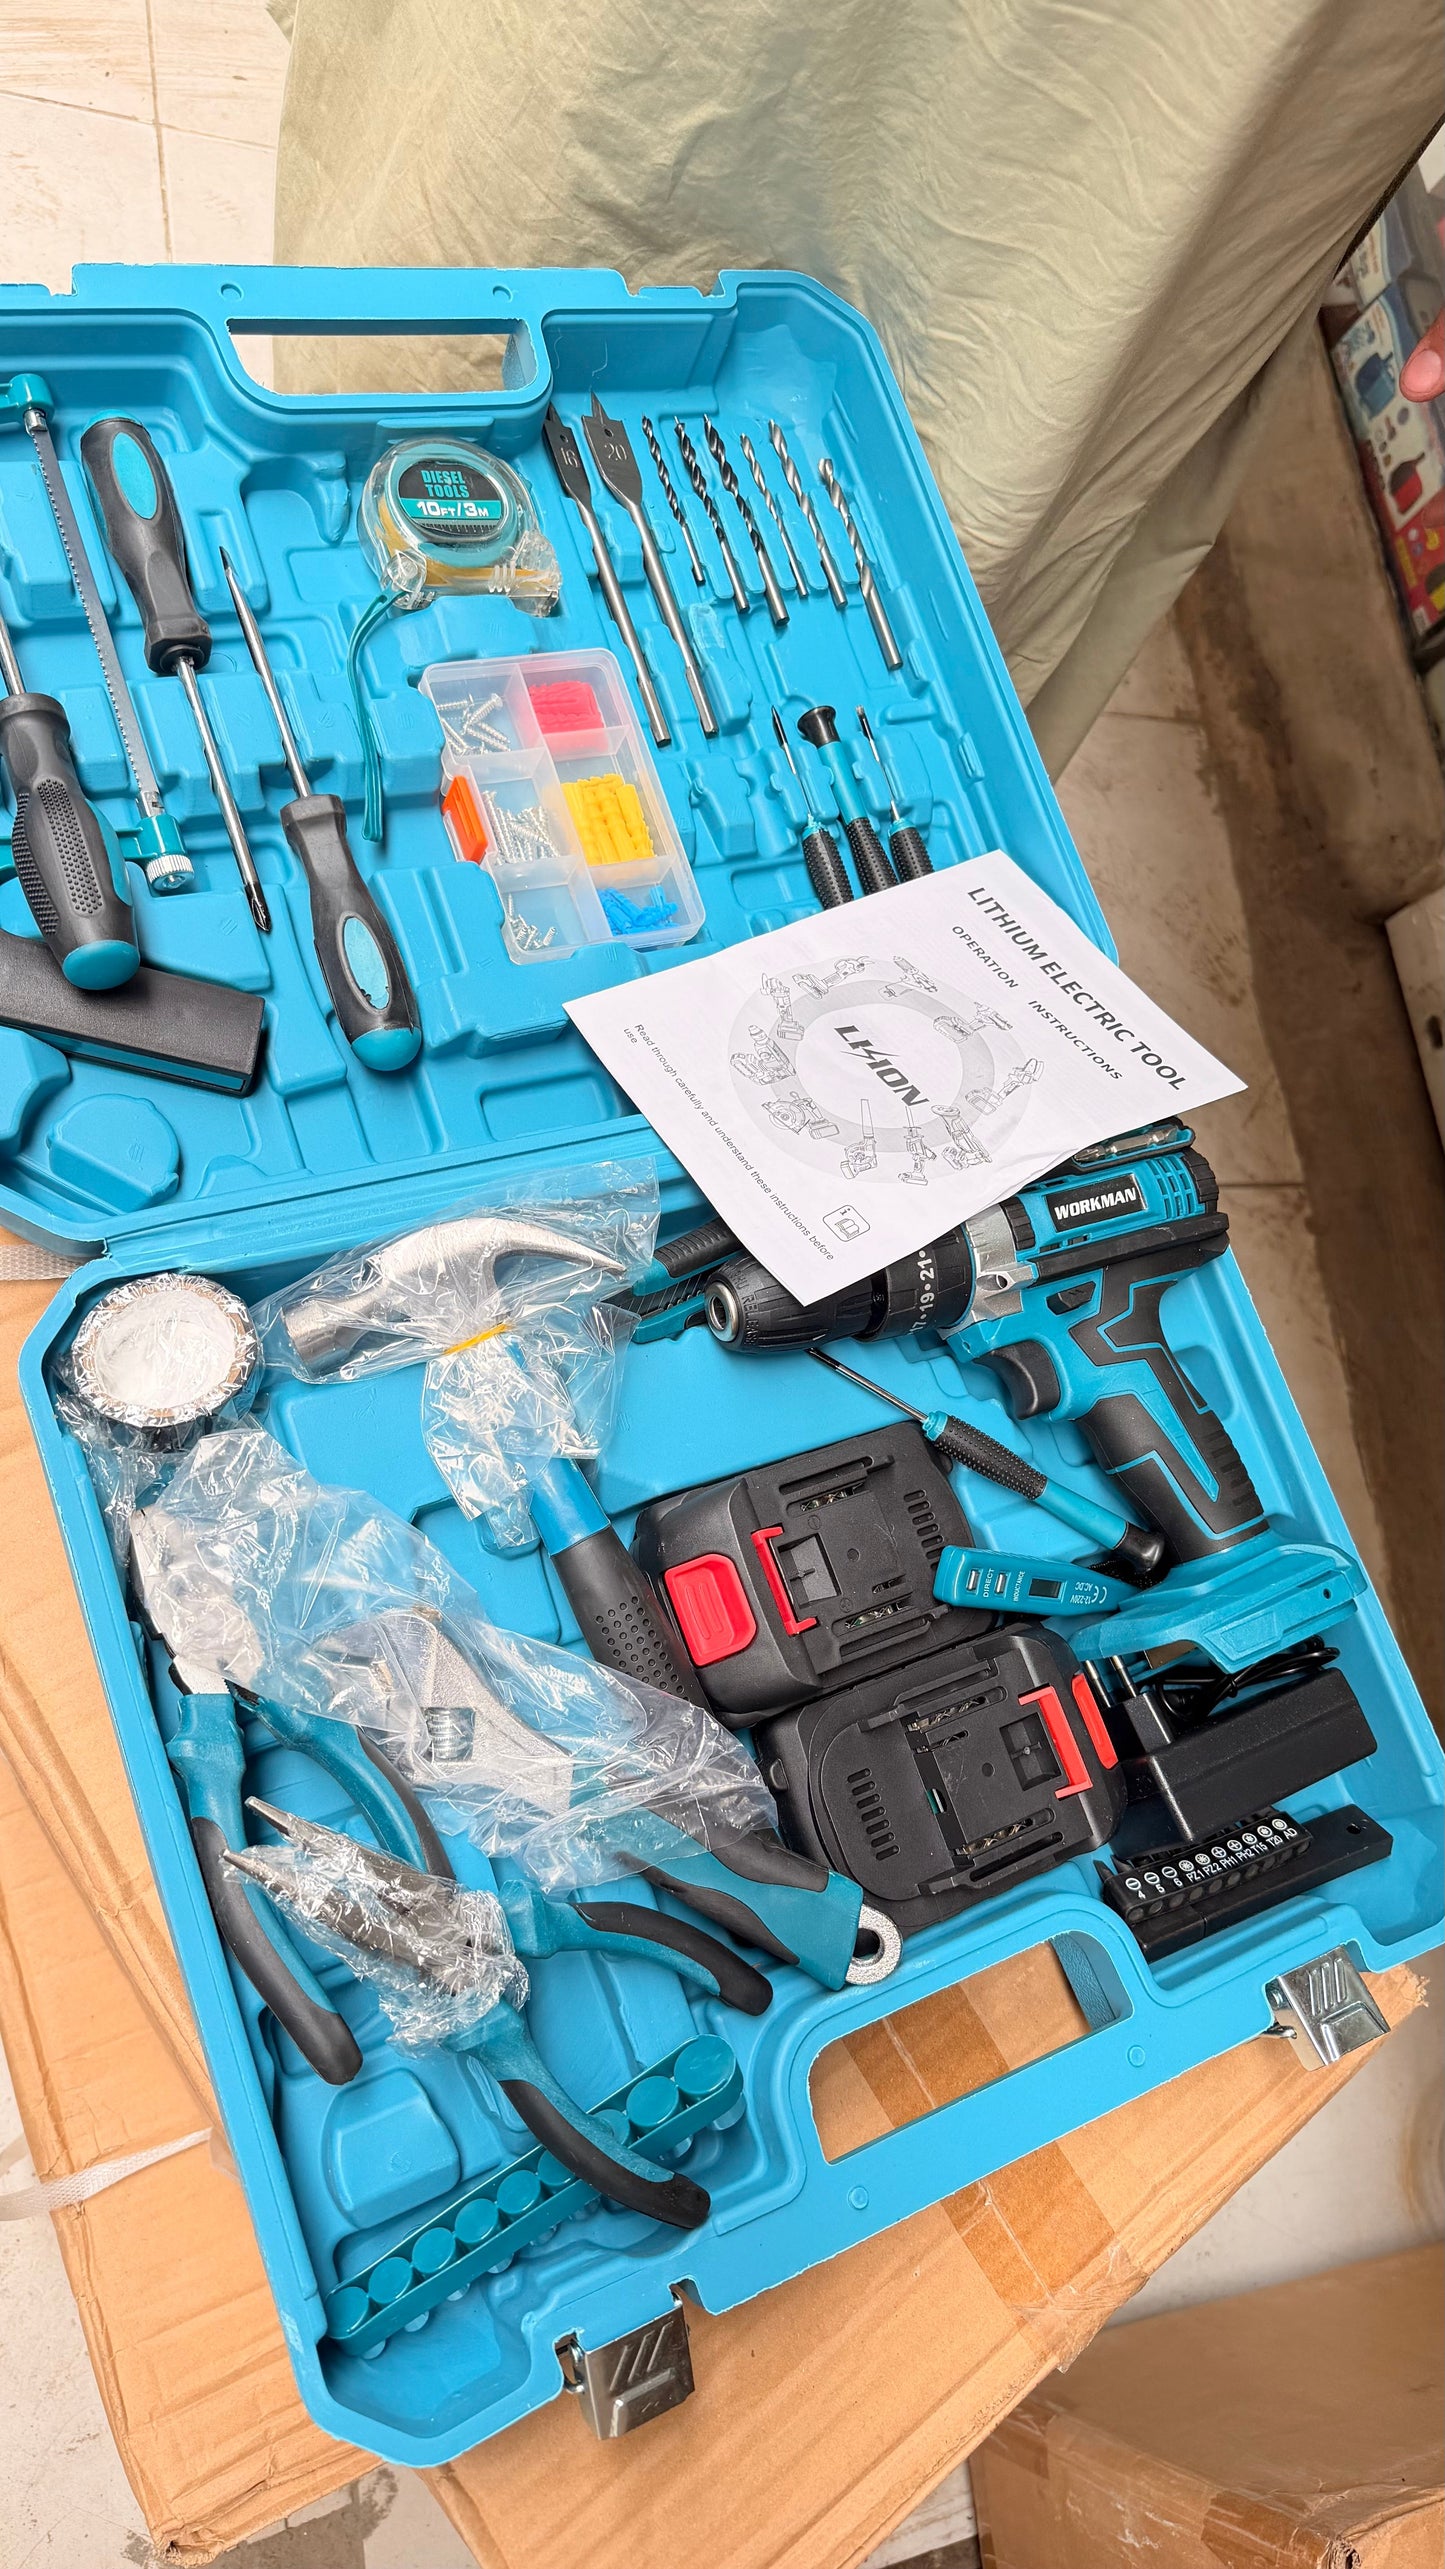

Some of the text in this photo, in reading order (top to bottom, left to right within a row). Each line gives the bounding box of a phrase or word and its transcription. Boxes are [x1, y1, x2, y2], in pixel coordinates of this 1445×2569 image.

[560, 447, 579, 468] 16
[604, 443, 628, 461] 20
[421, 470, 465, 484] DIESEL
[425, 484, 470, 498] TOOLS
[967, 887, 1188, 1090] LITHIUM ELECTRIC TOOL
[952, 925, 1123, 1080] OPERATION INSTRUCTIONS
[623, 1028, 638, 1044] use
[634, 1023, 834, 1261] Read through carefully and understand these instructions before
[1054, 1186, 1137, 1221] WORKMAN
[917, 1258, 935, 1281] 21
[919, 1292, 935, 1312] 19
[982, 1567, 995, 1598] DIRECT
[1013, 1570, 1026, 1602] INDUCTANCE
[1138, 1890, 1146, 1900] 4
[1155, 1883, 1166, 1894] 5
[1173, 1877, 1183, 1888] 6
[1185, 1869, 1206, 1883] PZ1
[1202, 1863, 1222, 1877] PZ2
[1220, 1855, 1239, 1870] PH1
[1235, 1848, 1255, 1863] PH2
[1251, 1843, 1268, 1856] T15
[1266, 1835, 1283, 1848] T20
